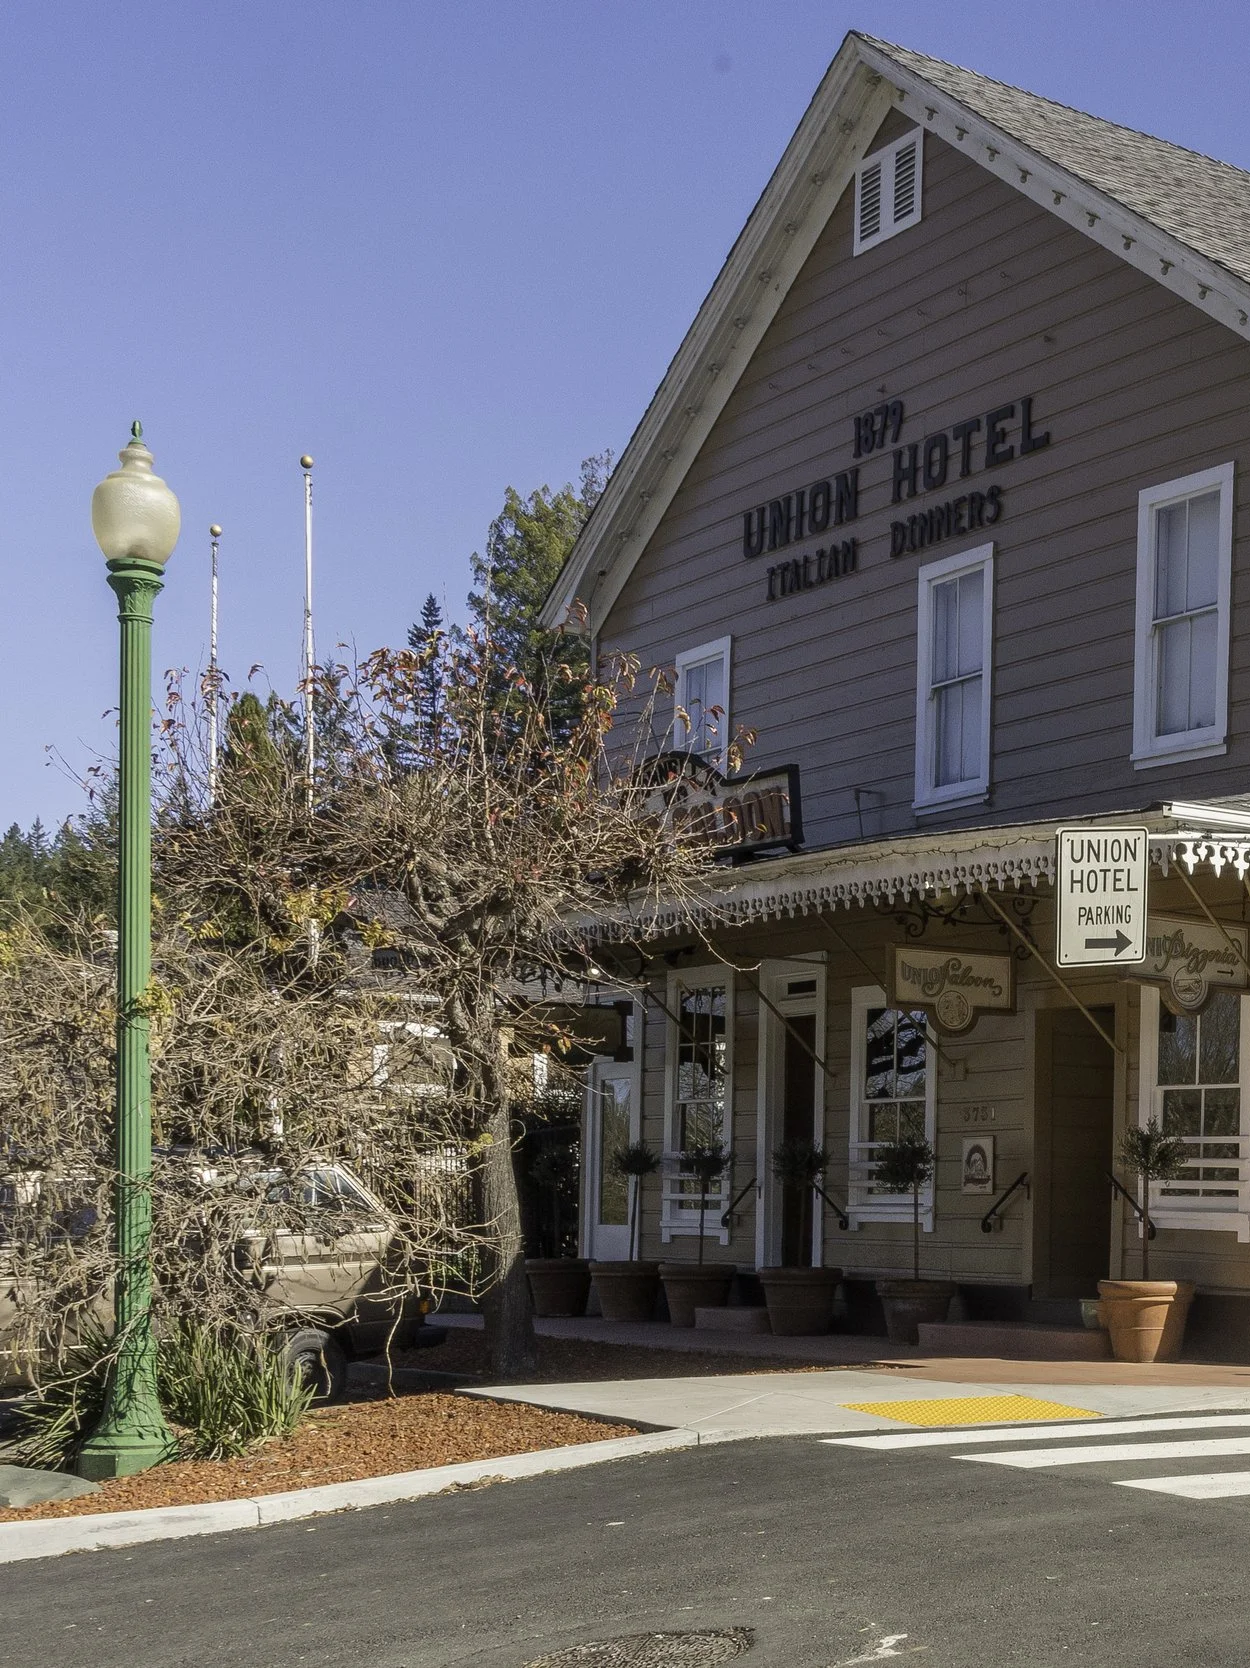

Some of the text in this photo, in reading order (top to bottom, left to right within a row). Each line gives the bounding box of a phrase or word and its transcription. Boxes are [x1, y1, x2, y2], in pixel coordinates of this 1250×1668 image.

[852, 400, 903, 458] 1879
[742, 397, 1050, 559] UNION HOTEL
[765, 485, 1003, 601] ITALIAN DINNERS
[1070, 838, 1137, 864] UNION
[1070, 868, 1138, 893] HOTEL
[1078, 904, 1132, 926] PARKING
